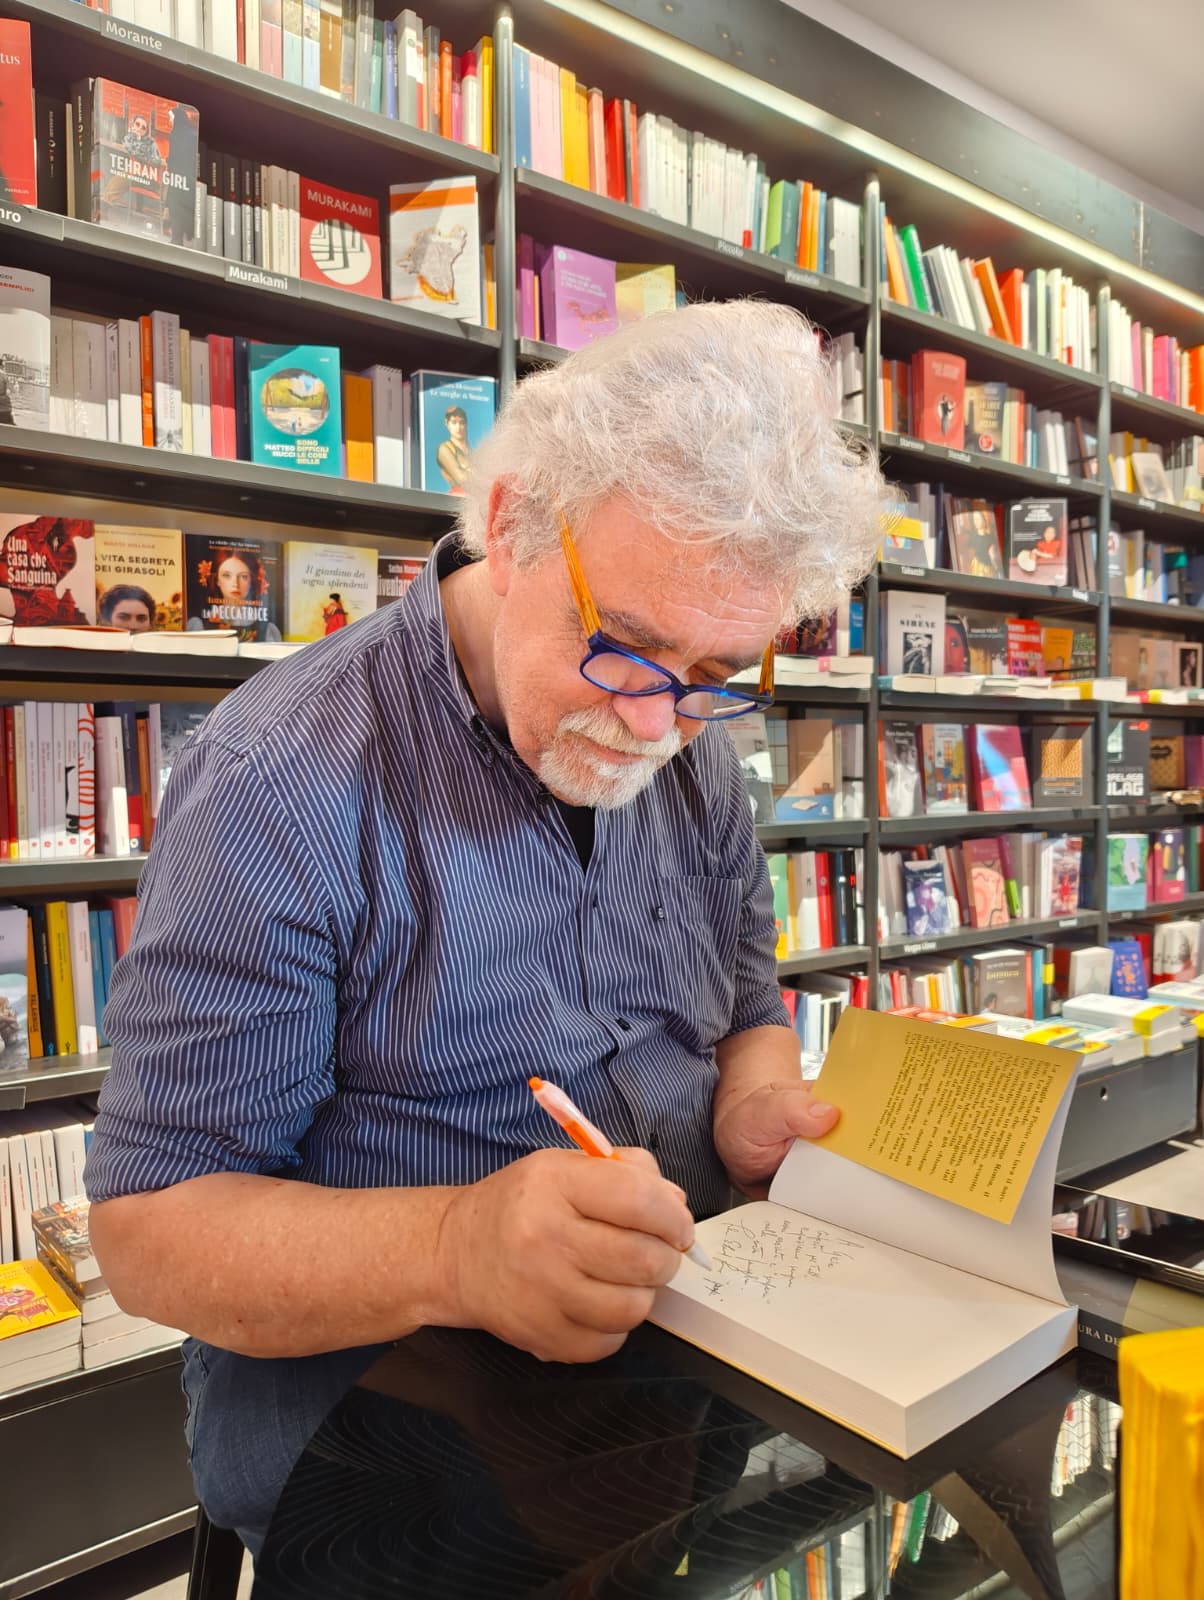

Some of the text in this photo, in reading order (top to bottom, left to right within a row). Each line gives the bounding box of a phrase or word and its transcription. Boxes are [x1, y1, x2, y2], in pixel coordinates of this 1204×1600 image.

[105, 20, 163, 50] Morante
[110, 152, 190, 191] TEHRAN GIRL
[307, 189, 372, 218] MURAKAMI
[228, 266, 288, 290] Murakami
[7, 537, 27, 553] Una
[7, 552, 47, 568] casa che
[100, 554, 176, 566] VITA SEGRETA
[8, 568, 57, 586] Sanguina
[114, 566, 166, 576] GIRASOLI
[306, 564, 366, 578] Il giardino dei
[212, 605, 268, 622] PECCATRICE
